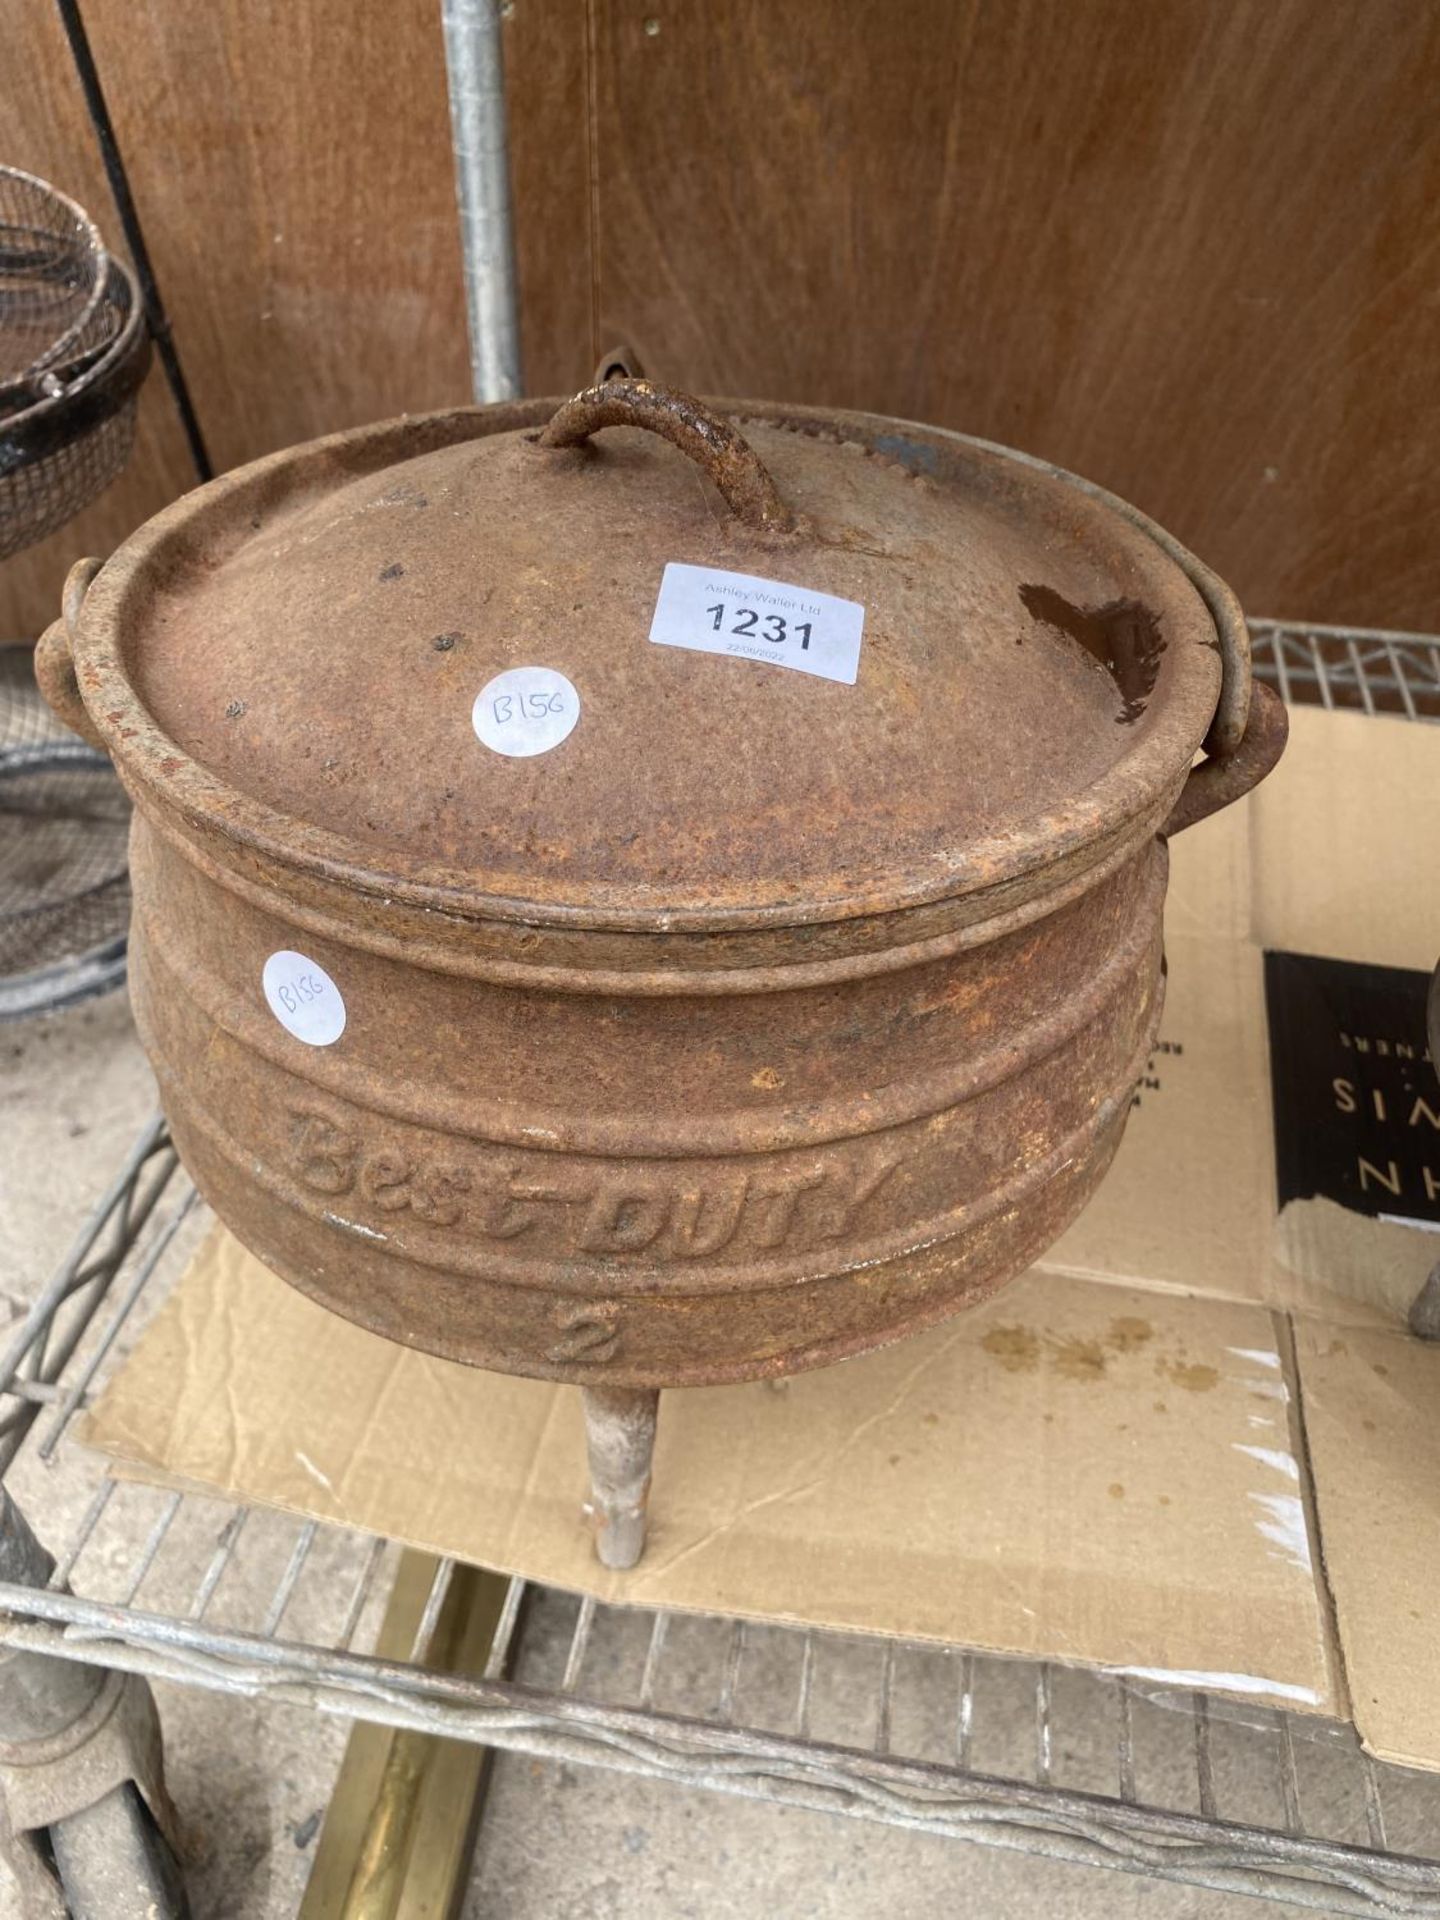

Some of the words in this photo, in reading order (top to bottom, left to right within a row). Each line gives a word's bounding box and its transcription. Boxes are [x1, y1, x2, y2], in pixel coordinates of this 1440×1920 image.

[703, 582, 751, 601] Ashley
[799, 602, 822, 617] Ltd
[705, 602, 814, 651] 1231
[493, 691, 565, 724] B156
[543, 1299, 622, 1364] 2
